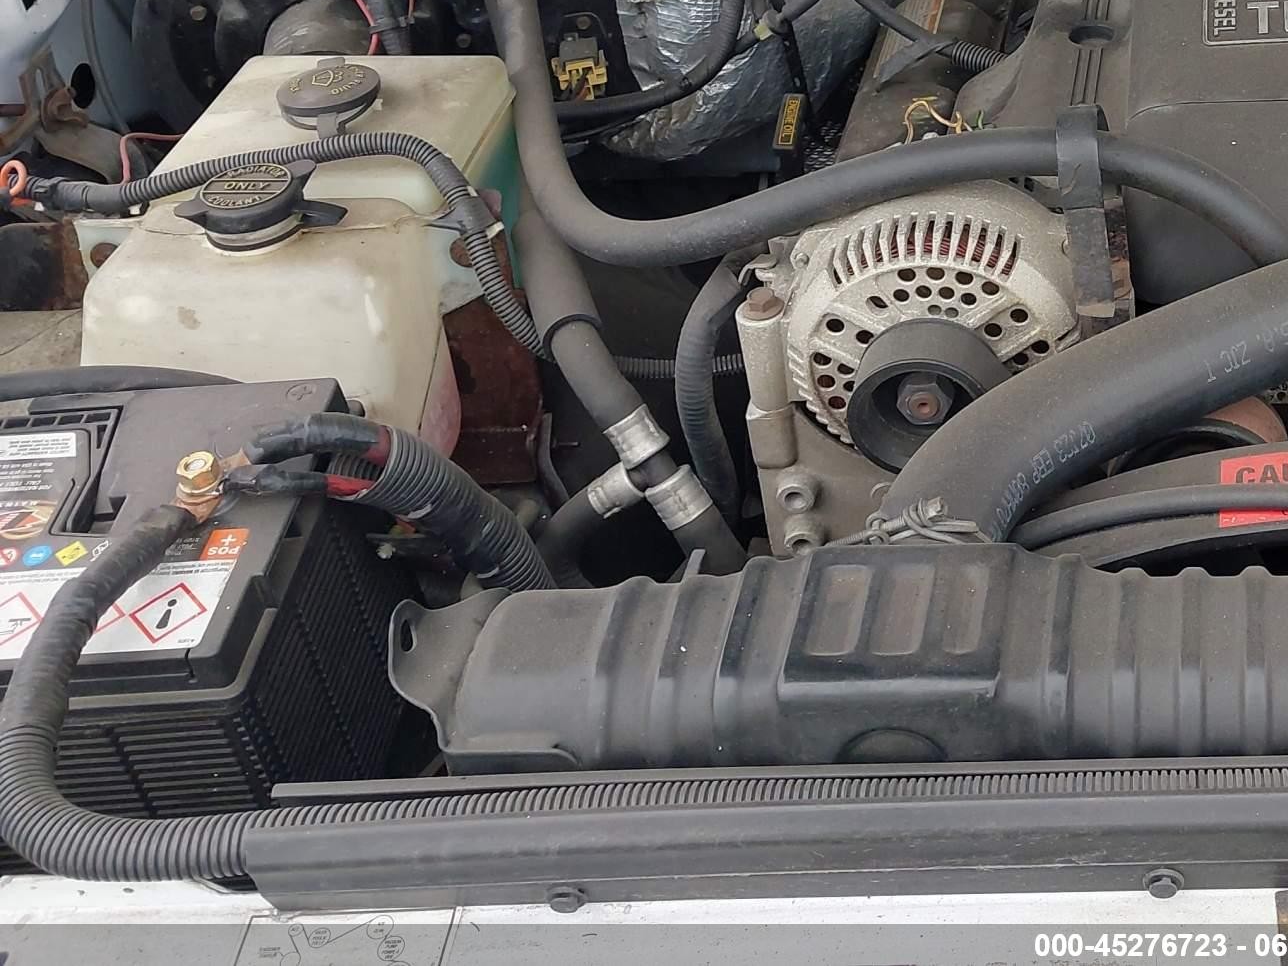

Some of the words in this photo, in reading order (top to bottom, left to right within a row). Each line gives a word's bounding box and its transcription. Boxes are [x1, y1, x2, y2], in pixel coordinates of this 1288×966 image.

[782, 124, 794, 138] OIL
[226, 165, 286, 178] RADIATOR
[224, 181, 271, 190] ONLY
[207, 195, 262, 207] COOLANT
[206, 545, 241, 556] POS
